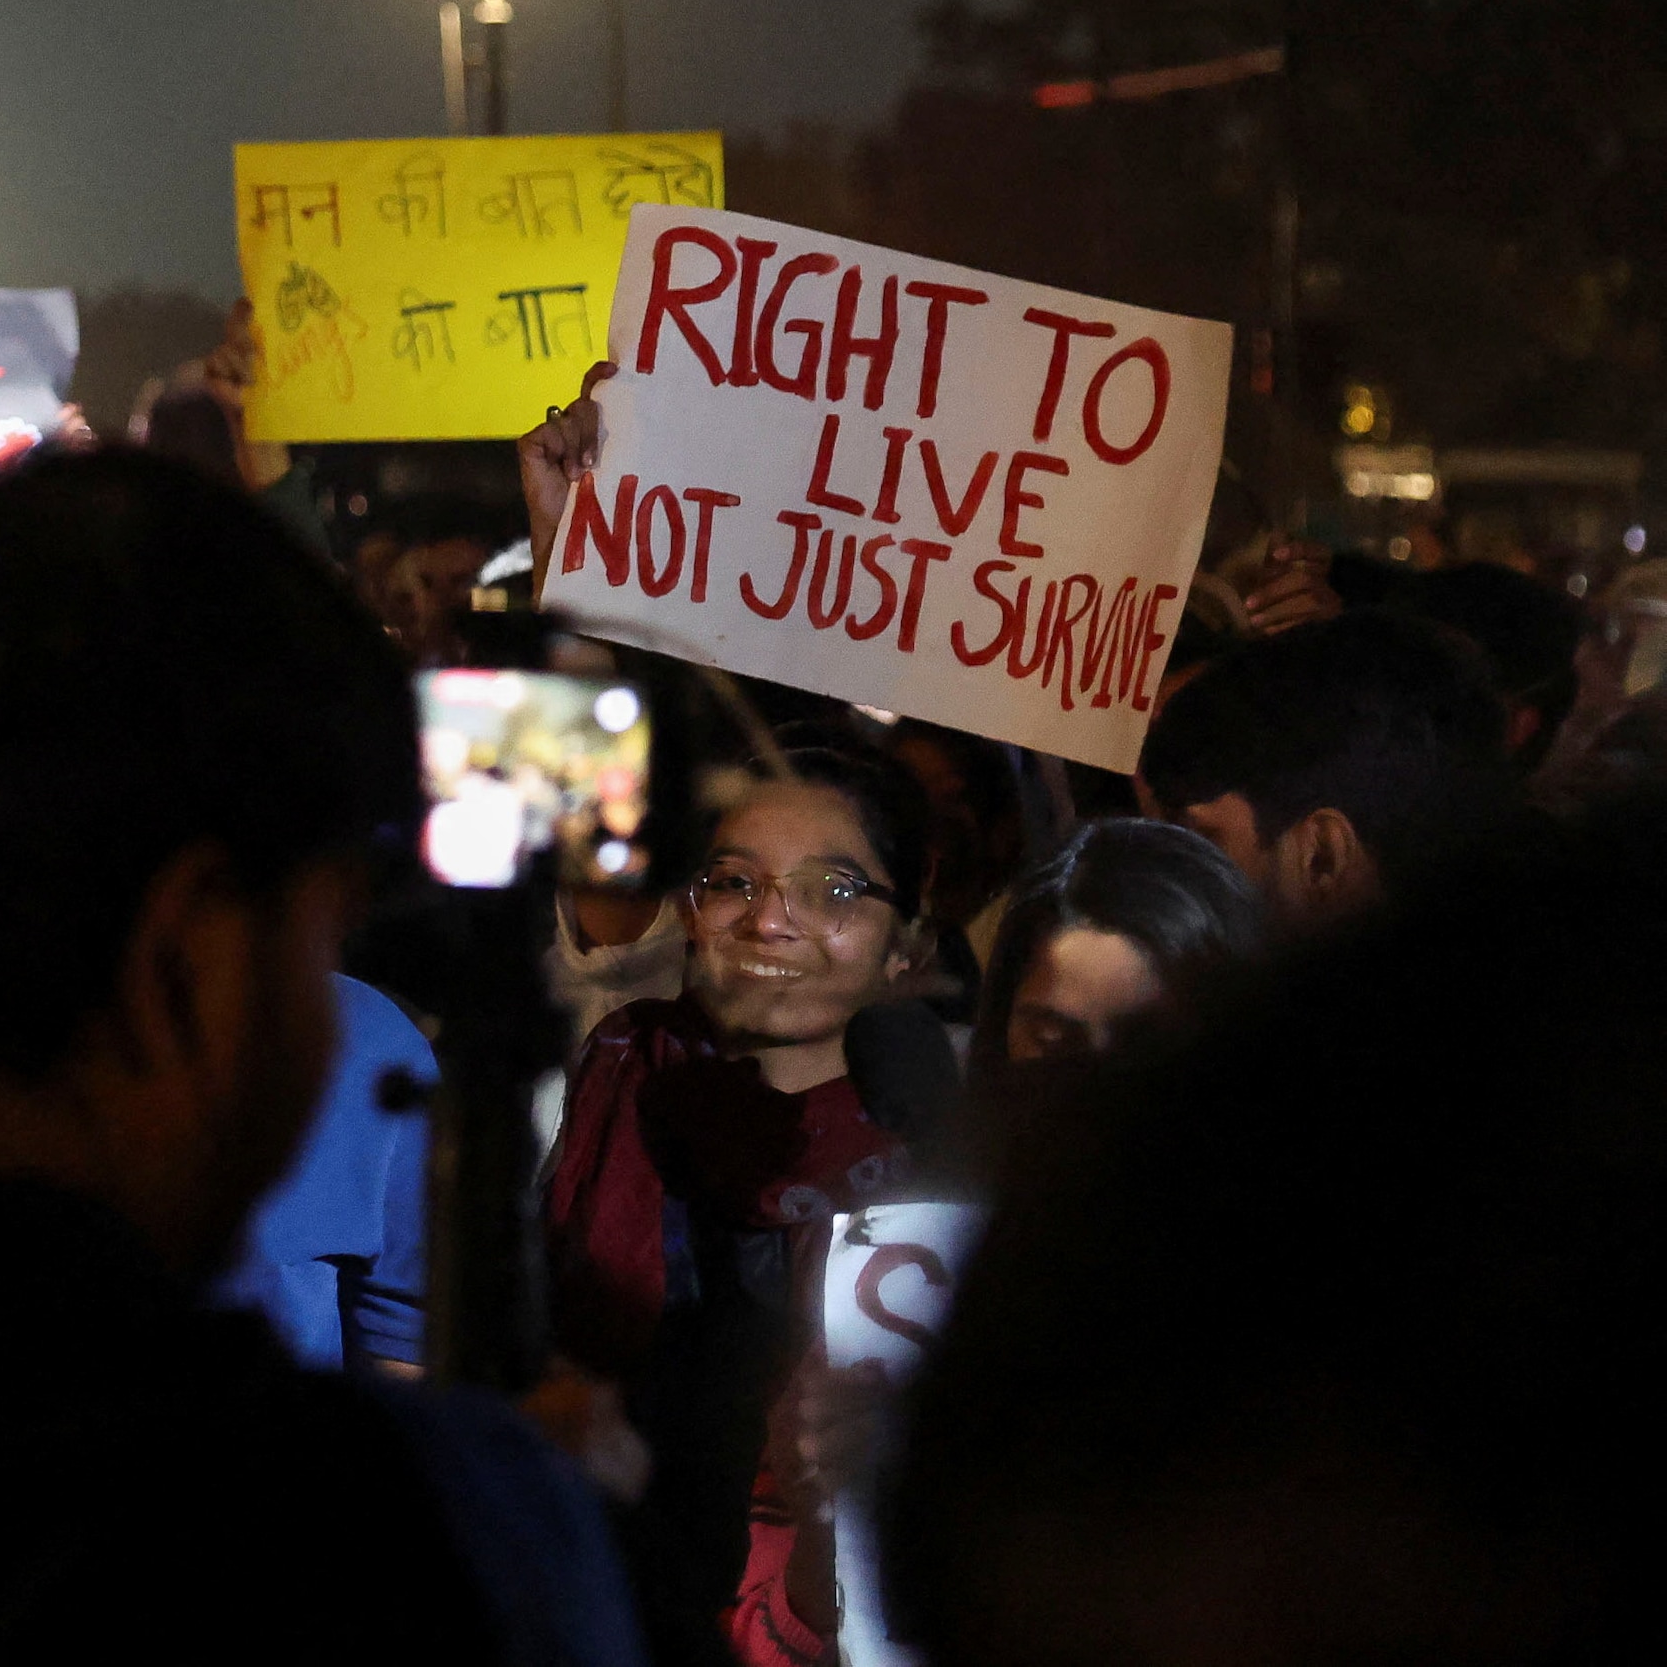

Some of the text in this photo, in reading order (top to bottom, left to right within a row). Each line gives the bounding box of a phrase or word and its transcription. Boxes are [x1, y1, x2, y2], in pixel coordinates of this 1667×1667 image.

[634, 225, 1172, 465] RIGHT TO
[561, 471, 1179, 713] NOT JUST SURVIVE
[805, 413, 1070, 558] LIVE
